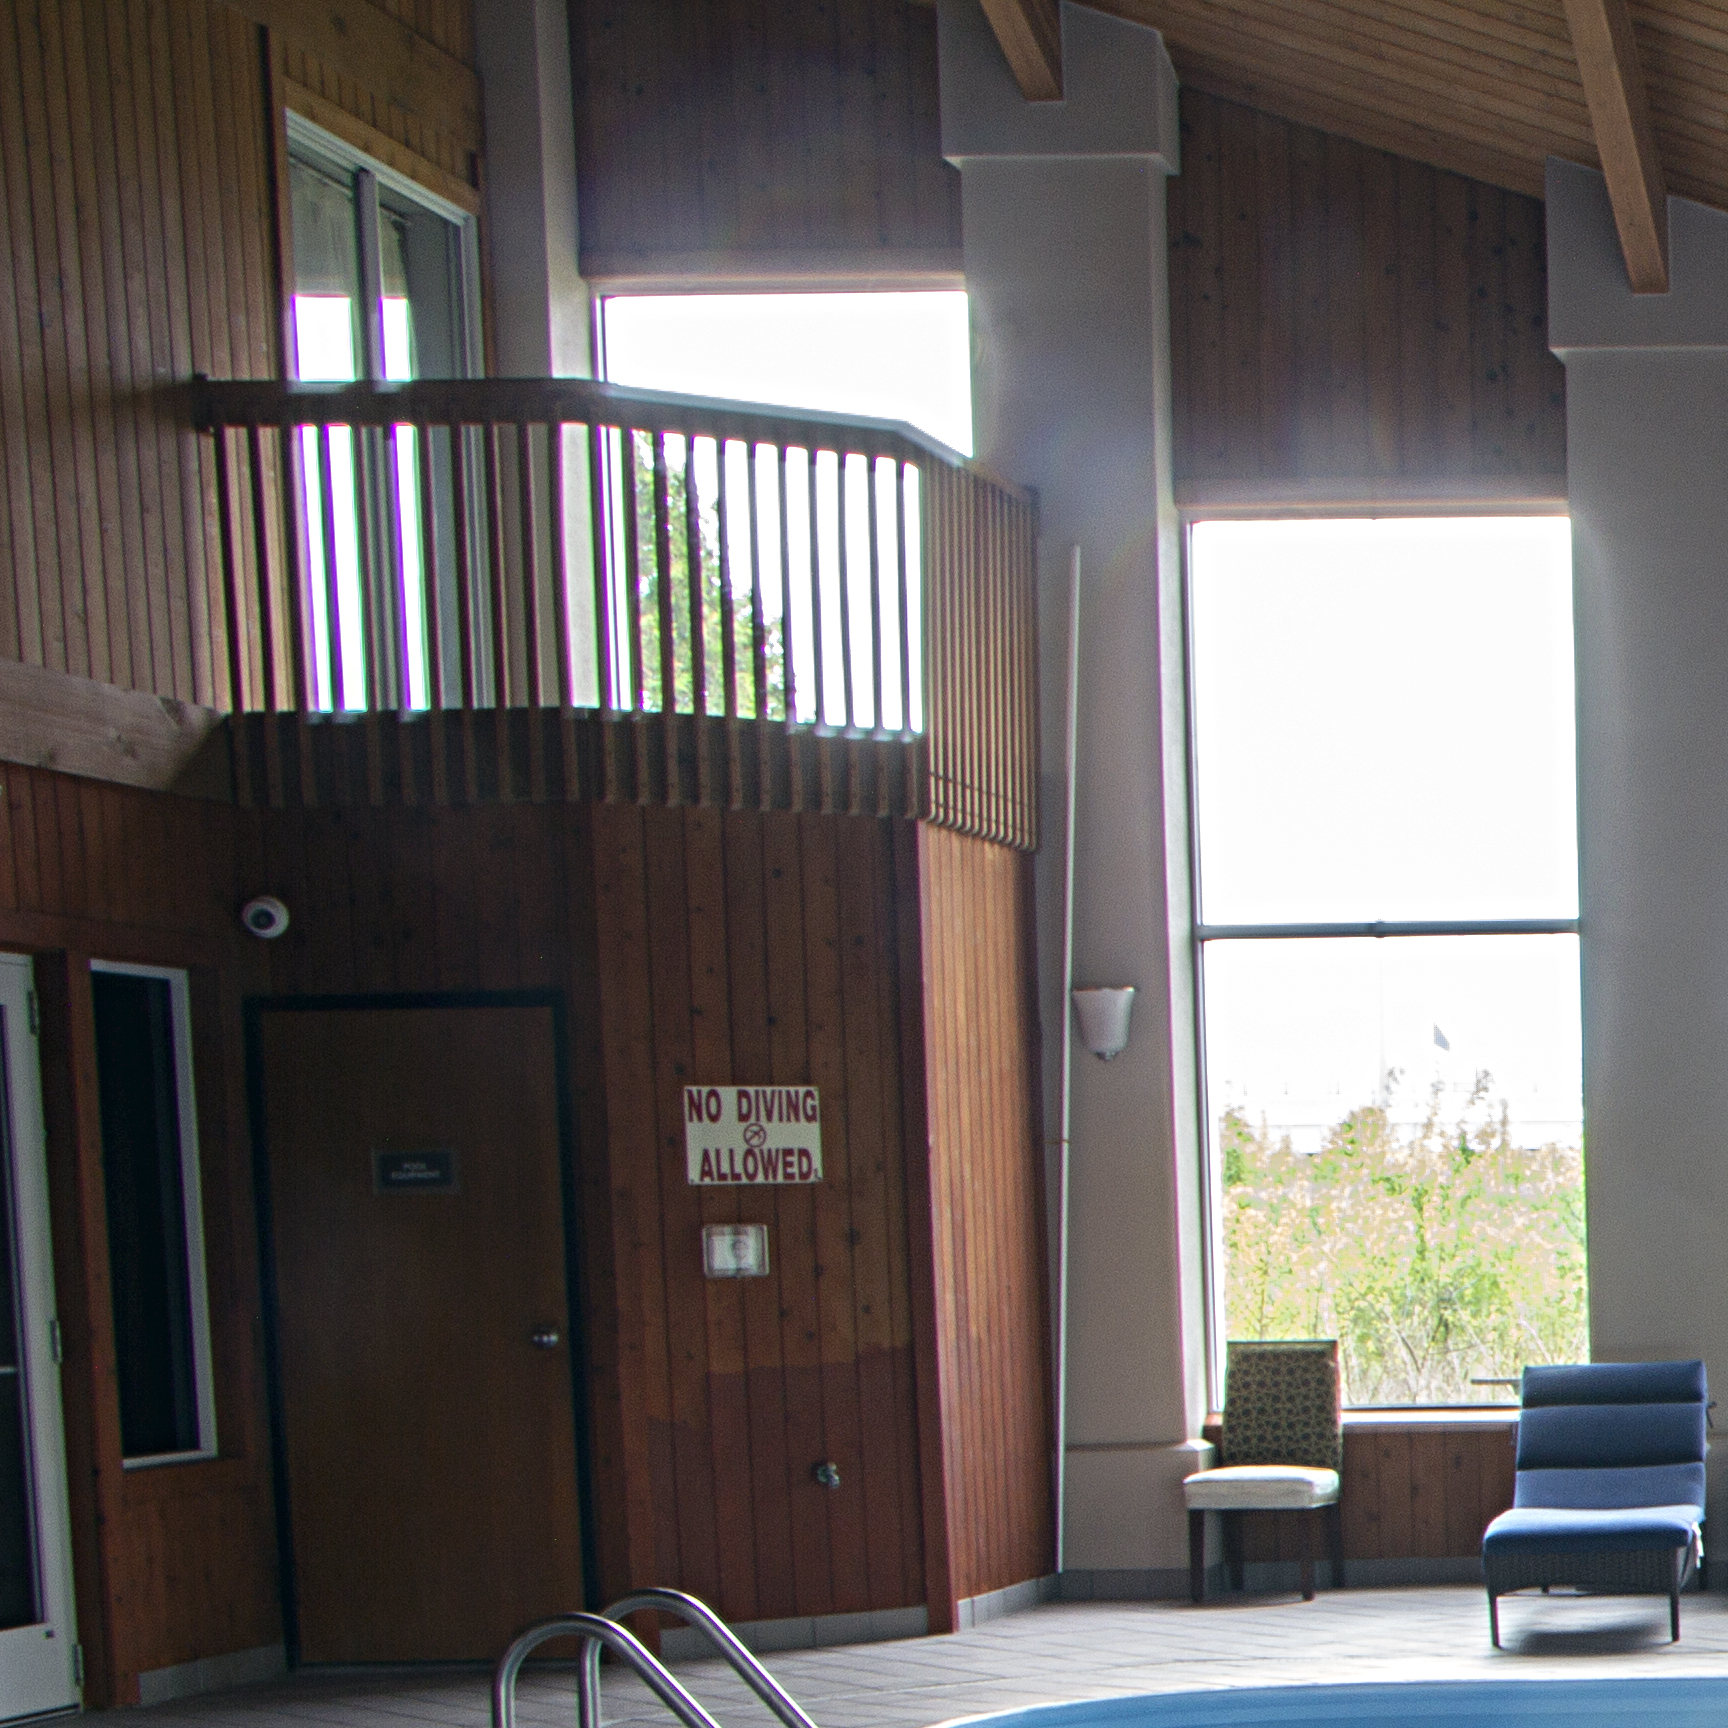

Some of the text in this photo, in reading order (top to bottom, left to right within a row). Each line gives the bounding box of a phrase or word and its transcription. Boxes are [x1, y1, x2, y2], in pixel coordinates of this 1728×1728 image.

[686, 1088, 818, 1123] NO DIVING
[700, 1148, 813, 1182] ALLOWED
